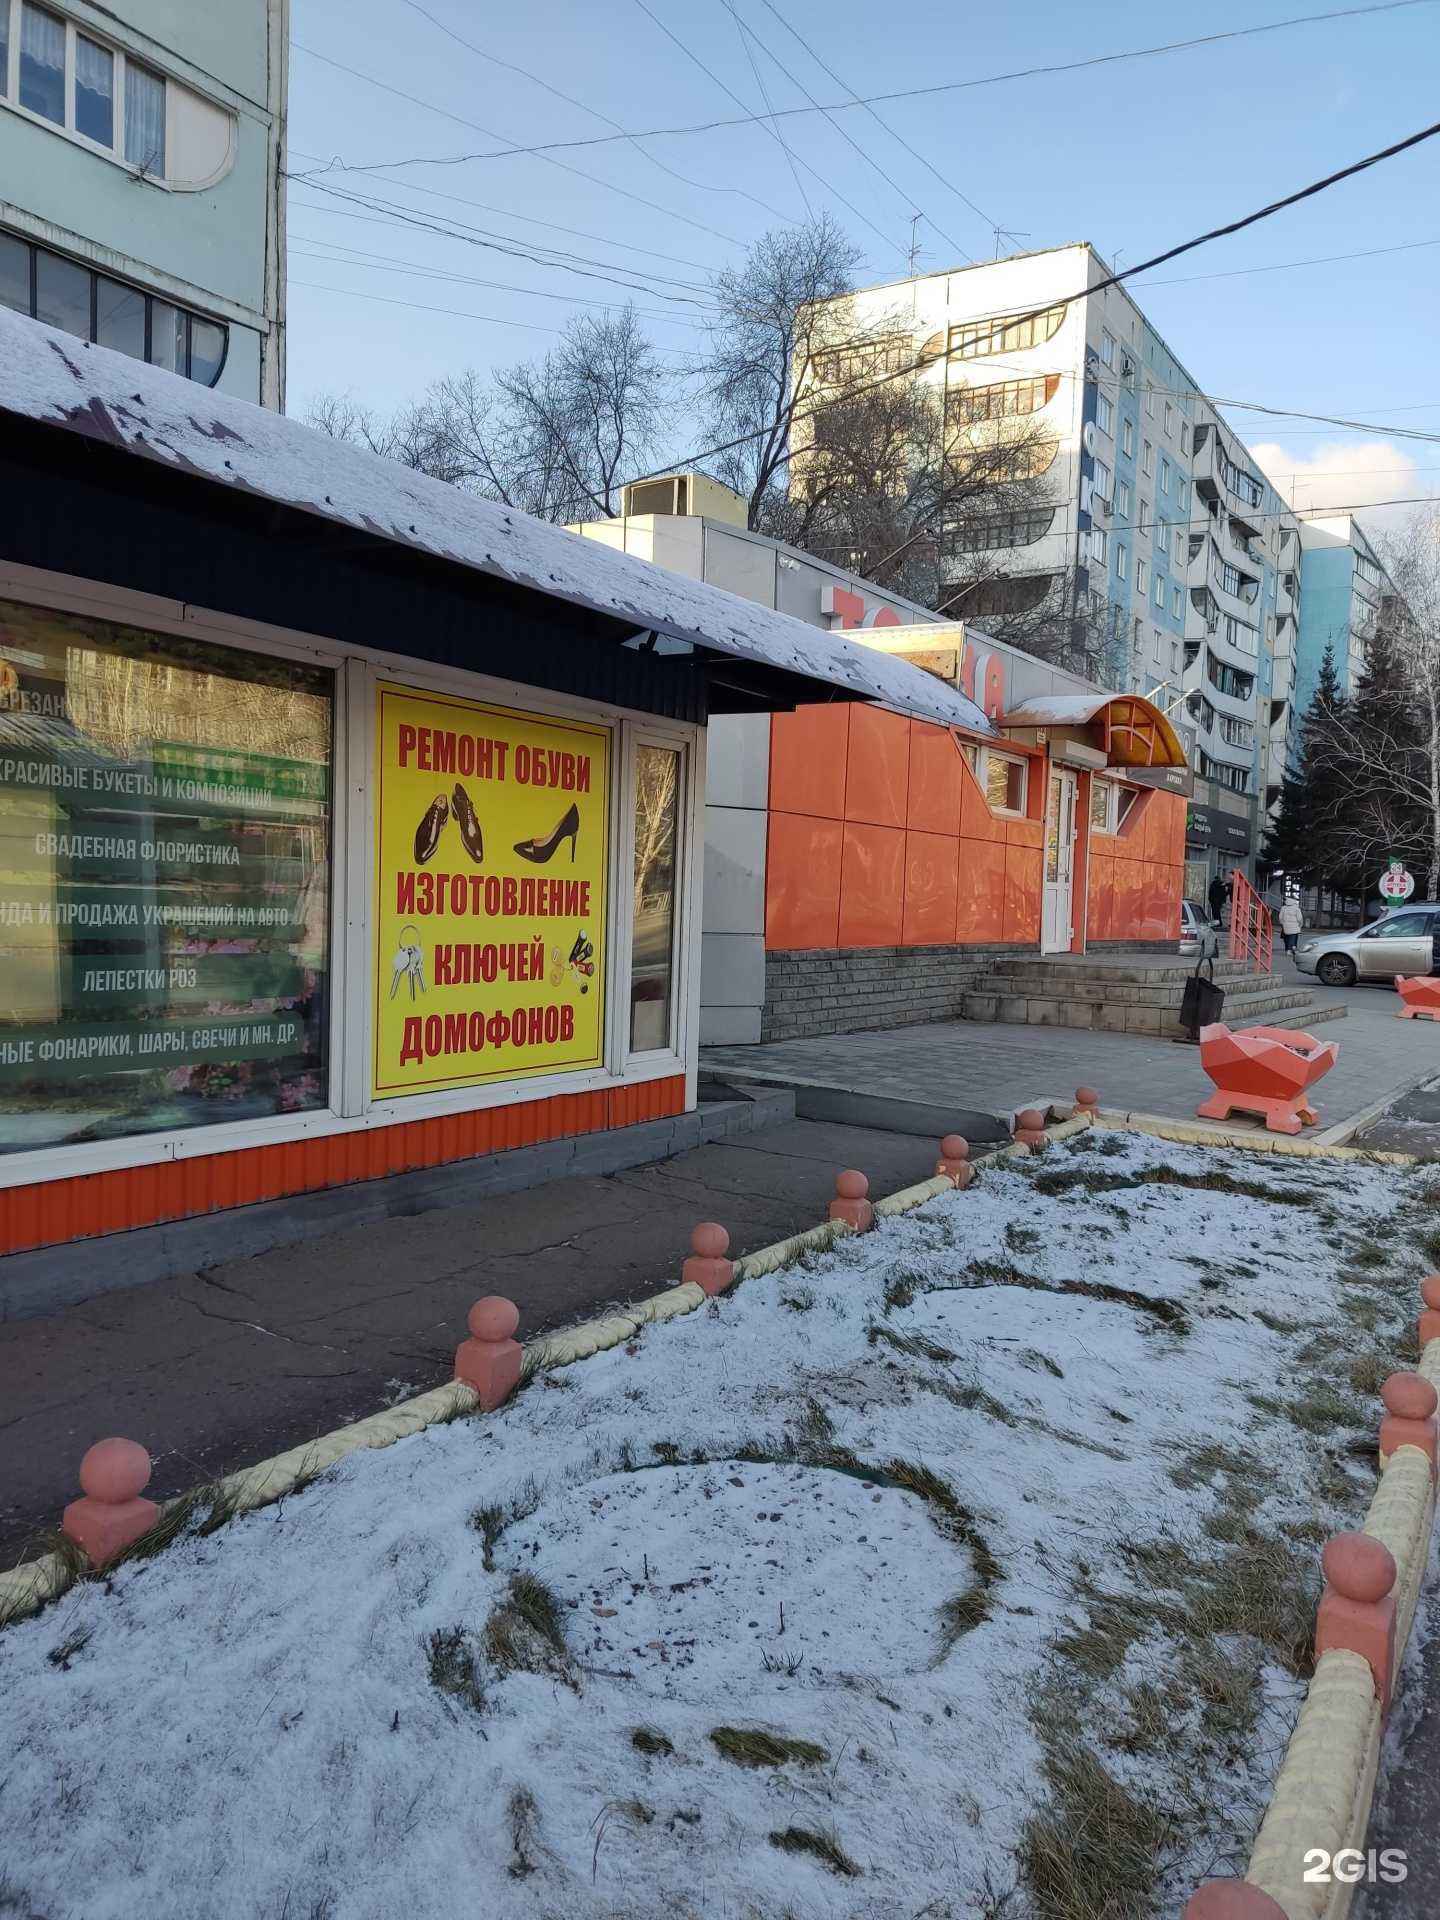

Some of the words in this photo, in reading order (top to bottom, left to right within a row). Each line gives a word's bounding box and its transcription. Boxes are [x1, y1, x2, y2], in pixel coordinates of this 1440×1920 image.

[399, 724, 509, 782] РЕМОНТ
[515, 744, 591, 793] ОБУВИ
[93, 767, 158, 798] БУКЕТЫ
[162, 775, 172, 798] И
[176, 778, 272, 808] КОМПОЗИЦИИ
[35, 833, 136, 860] СВАДЕБНАЯ
[140, 841, 240, 866] ФЛОРИСТИКА
[39, 902, 50, 924] И
[56, 903, 138, 927] ПРОДАЖА
[143, 904, 233, 926] УКРАШЕНИЙ
[237, 907, 254, 924] НА
[258, 908, 288, 926] АВТО
[396, 871, 591, 918] ИЗГОТОВЛЕНИЕ
[83, 969, 165, 992] ЛЕПЕСТКИ
[169, 969, 197, 989] РОЗ
[434, 935, 545, 986] КЛЮЧЕЙ
[38, 1034, 133, 1062] ФОНАРИКИ,
[138, 1031, 188, 1054] ШАРЫ,
[192, 1027, 237, 1050] СВЕЧИ
[239, 1026, 249, 1046] И
[252, 1024, 274, 1045] МН.
[277, 1023, 298, 1045] ДР.
[399, 1004, 574, 1067] ДОМОФОНОВ
